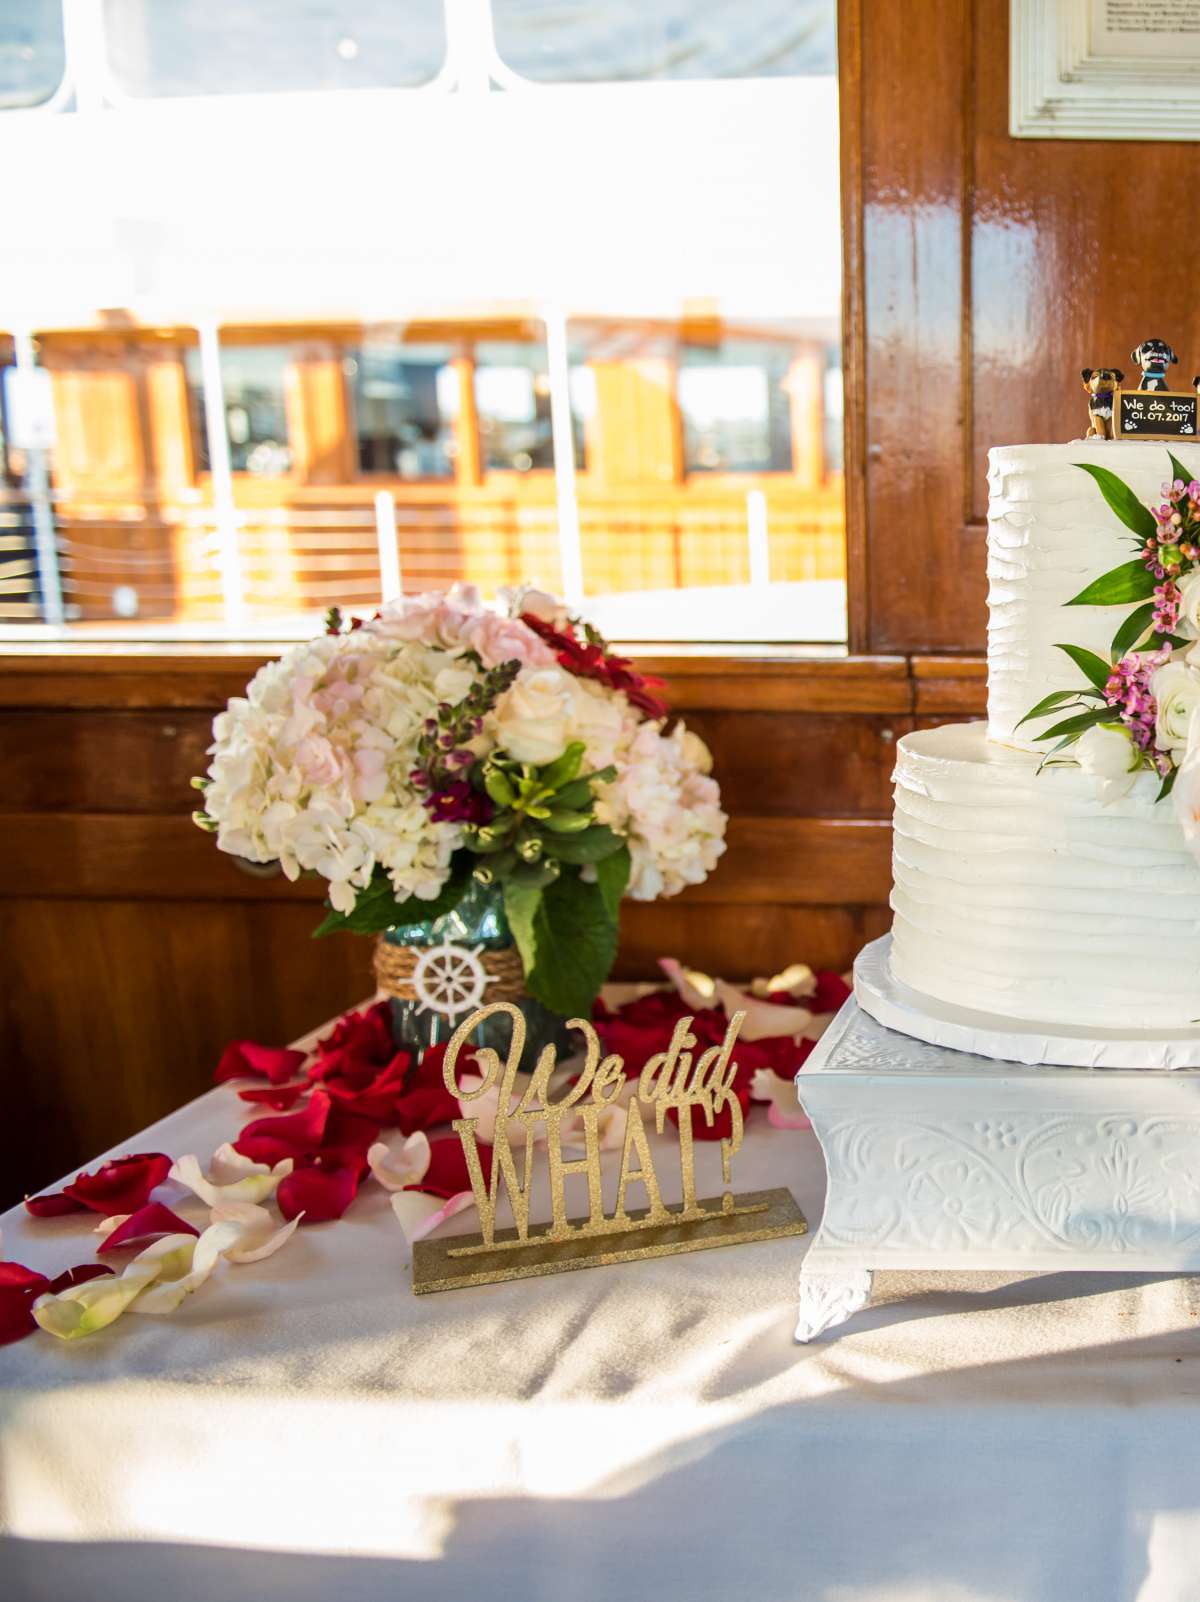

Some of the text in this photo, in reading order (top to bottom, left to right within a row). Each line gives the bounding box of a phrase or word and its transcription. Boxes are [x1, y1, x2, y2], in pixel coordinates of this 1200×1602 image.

[1123, 399, 1195, 413] We do too!
[1131, 411, 1189, 422] 01.07.2017
[442, 1001, 747, 1118] We did
[452, 1087, 745, 1247] WHAT?
